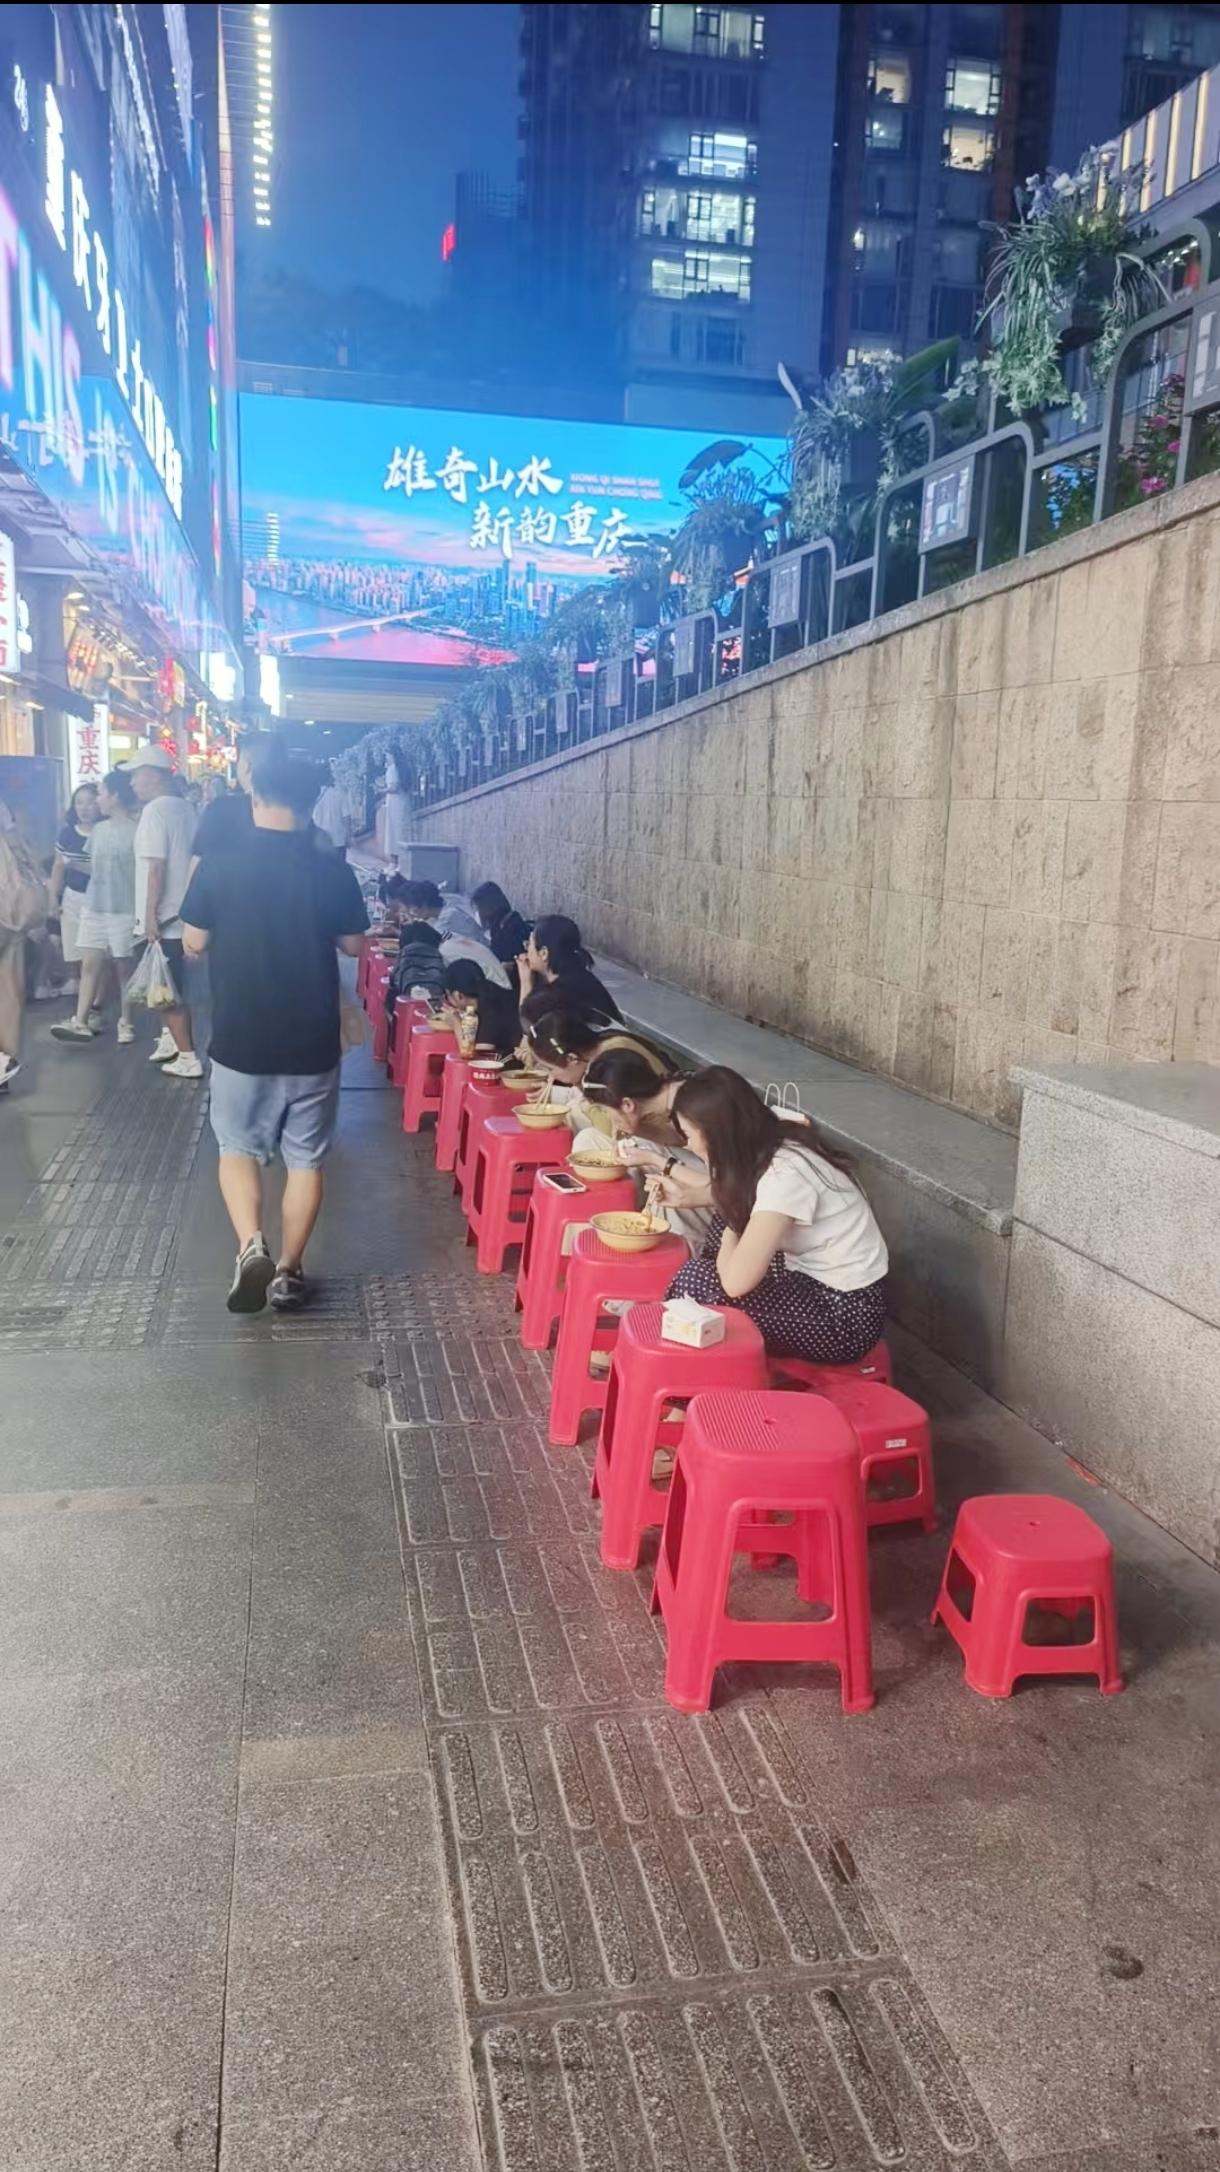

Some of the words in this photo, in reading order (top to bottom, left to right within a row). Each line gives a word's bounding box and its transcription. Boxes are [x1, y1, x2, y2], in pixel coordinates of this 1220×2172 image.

[384, 445, 564, 503] 雄奇山水
[469, 500, 649, 559] 新韵重庆
